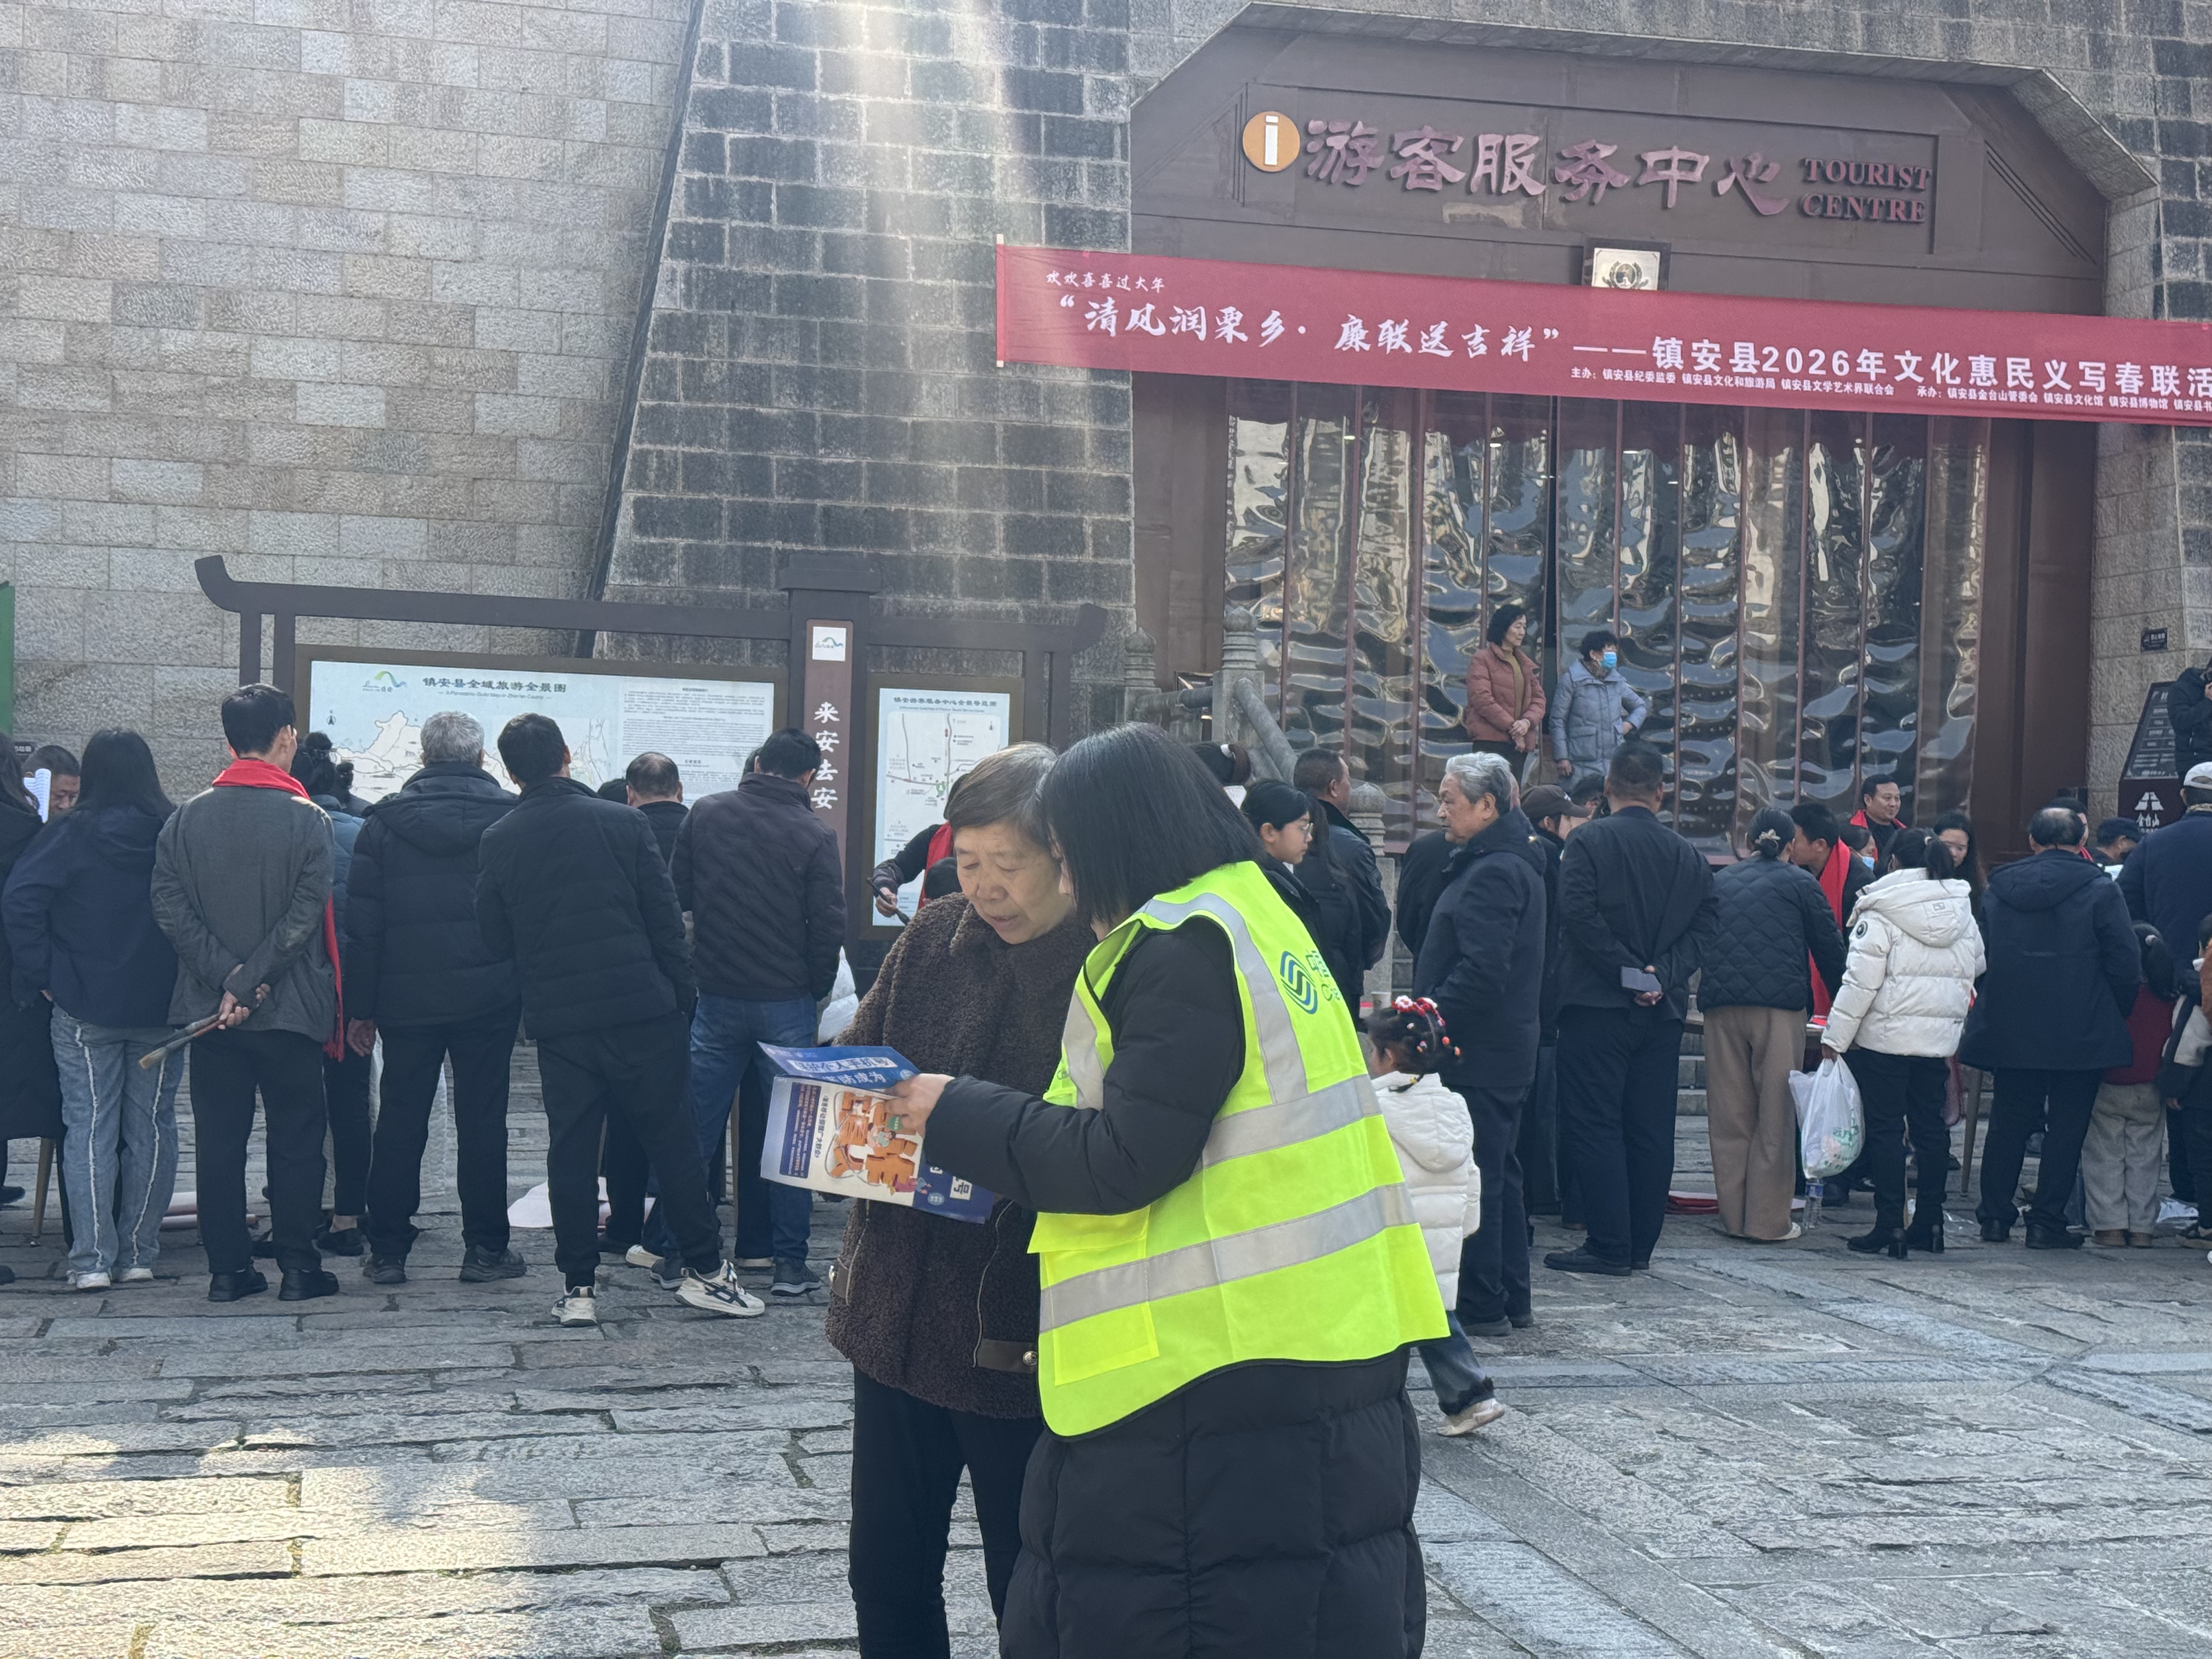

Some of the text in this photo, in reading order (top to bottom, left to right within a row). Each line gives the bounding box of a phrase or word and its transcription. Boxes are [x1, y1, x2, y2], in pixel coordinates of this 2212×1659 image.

[1306, 119, 1790, 216] 游客服务中心
[1803, 158, 1931, 190] TOURIST
[1801, 193, 1925, 222] CENTRE
[1046, 270, 1165, 294] 欢欢喜喜过大年
[811, 701, 839, 810] 来安去安
